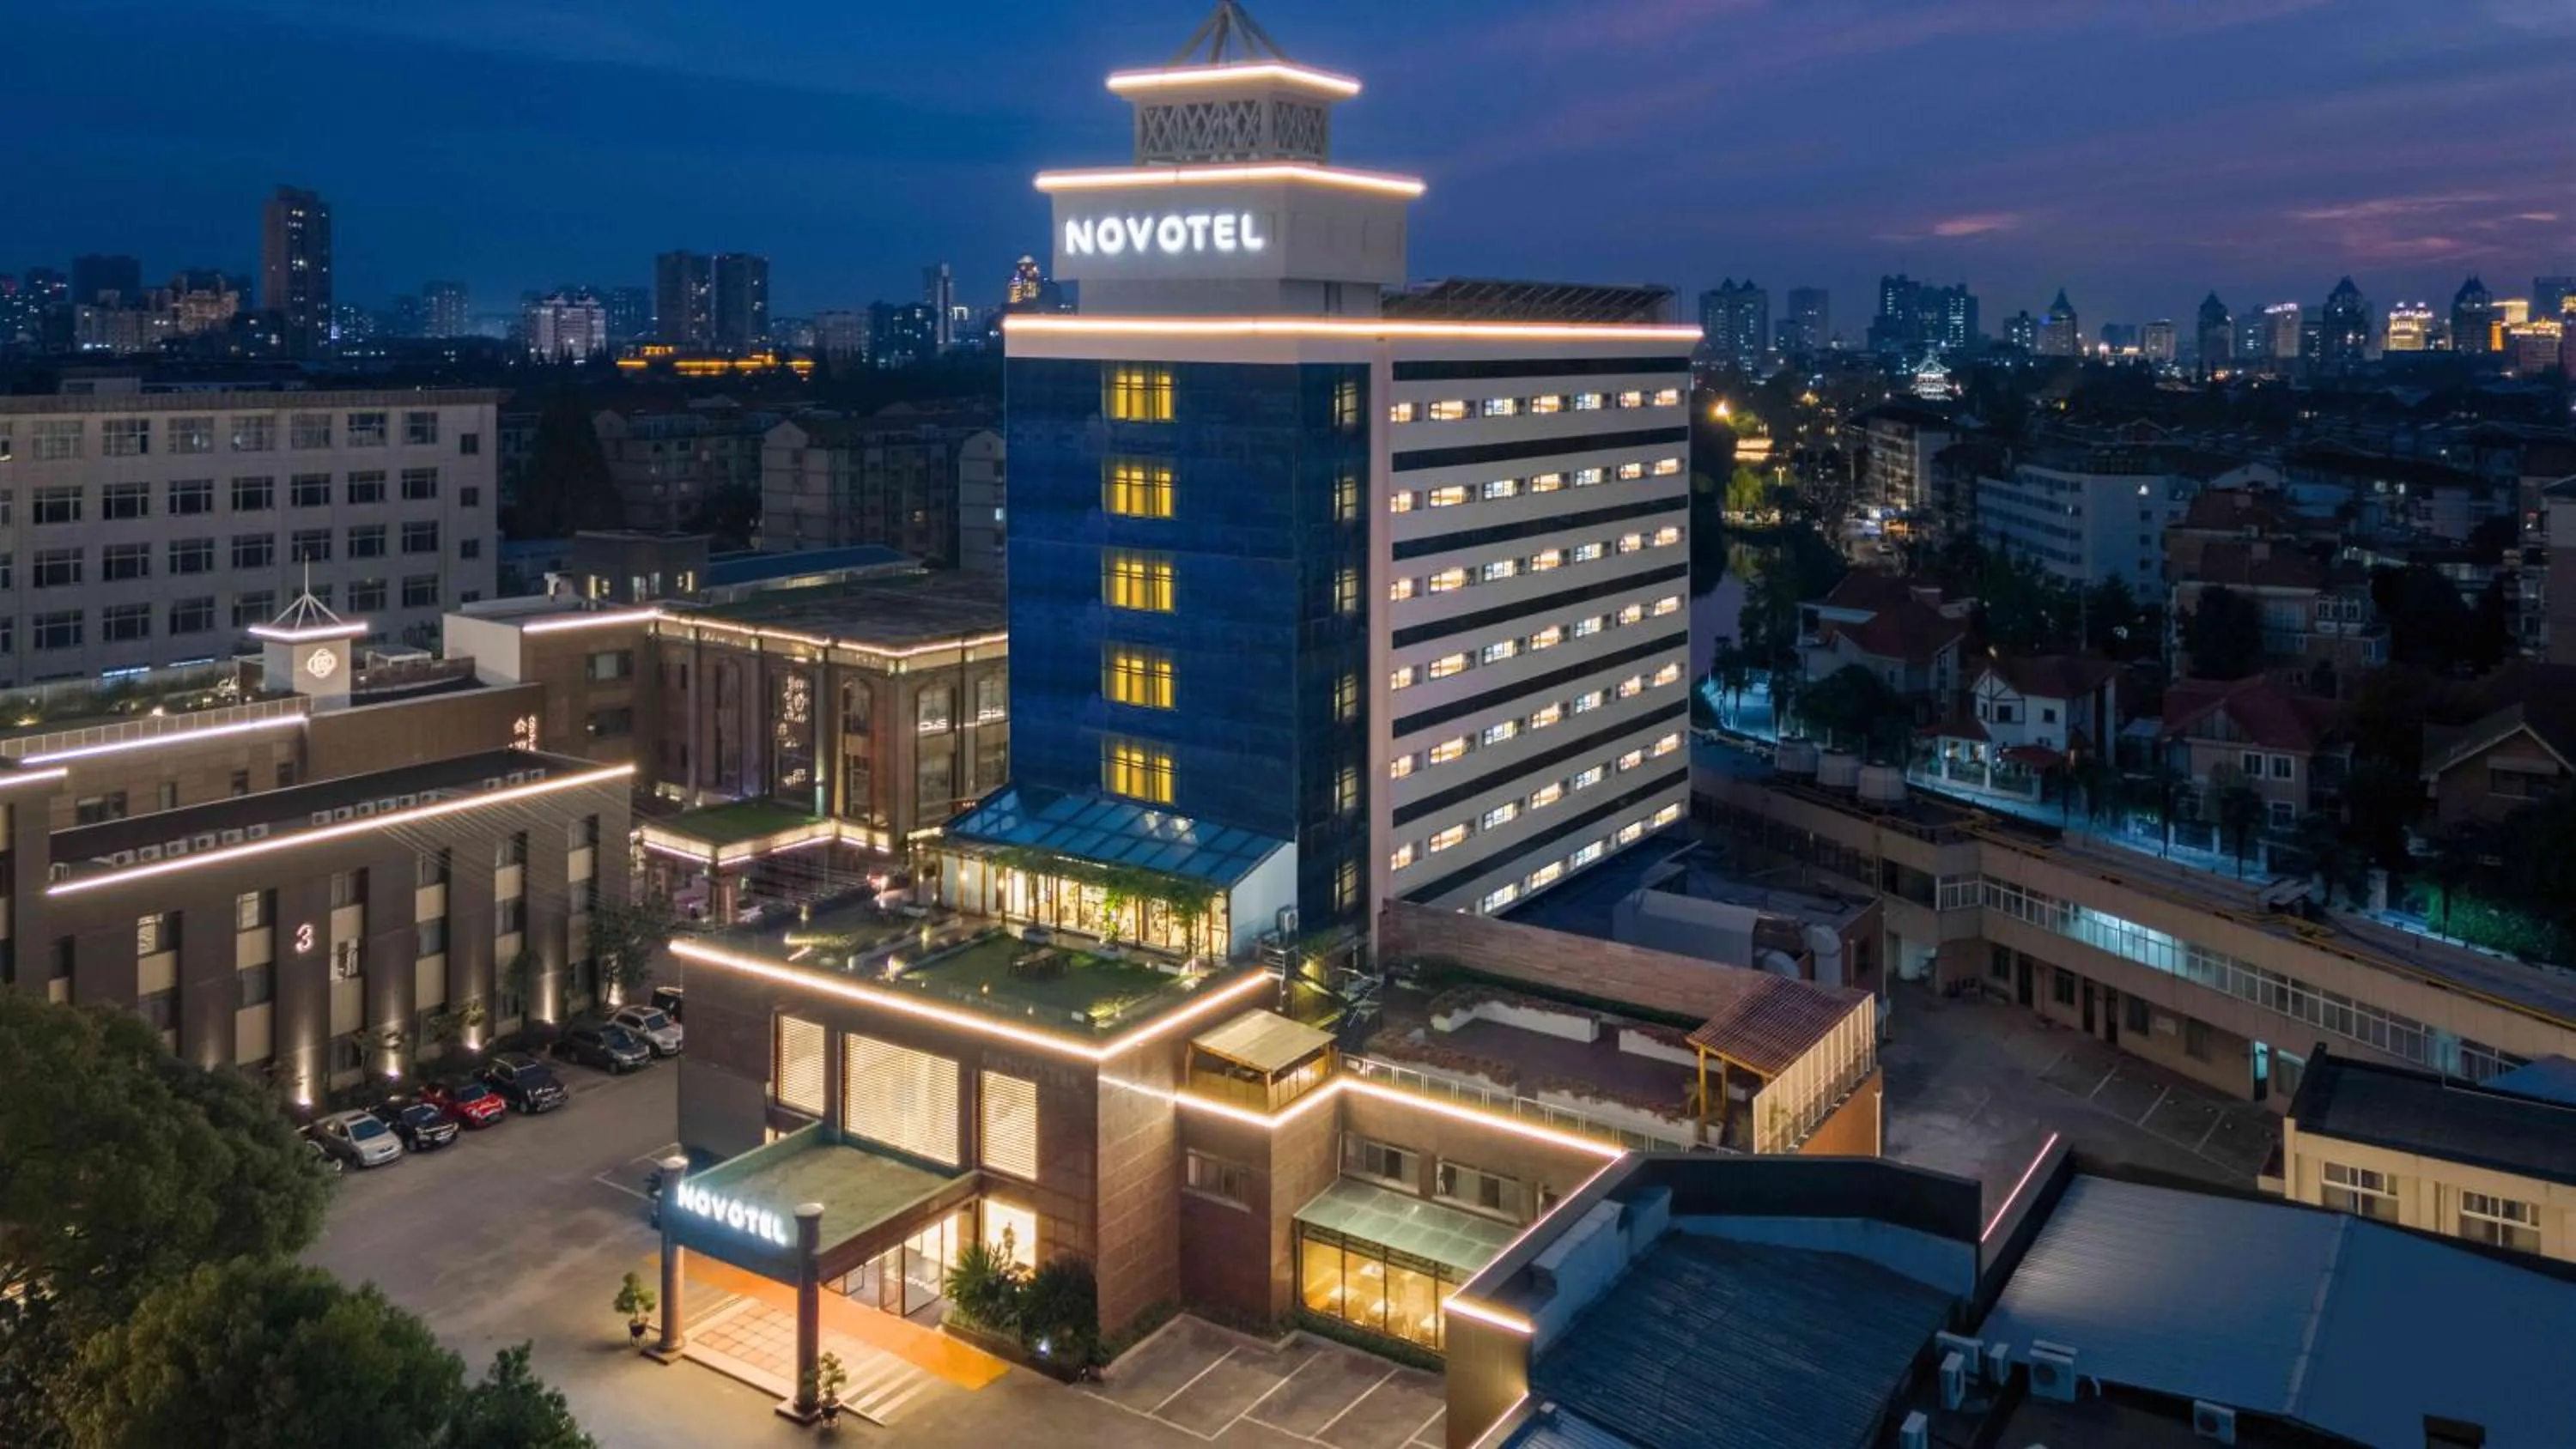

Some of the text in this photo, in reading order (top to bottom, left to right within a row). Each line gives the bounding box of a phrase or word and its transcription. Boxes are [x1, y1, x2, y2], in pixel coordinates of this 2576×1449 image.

[1064, 213, 1265, 255] NOVOTEL
[295, 922, 314, 954] 3
[677, 1180, 788, 1246] NOVOTEL
